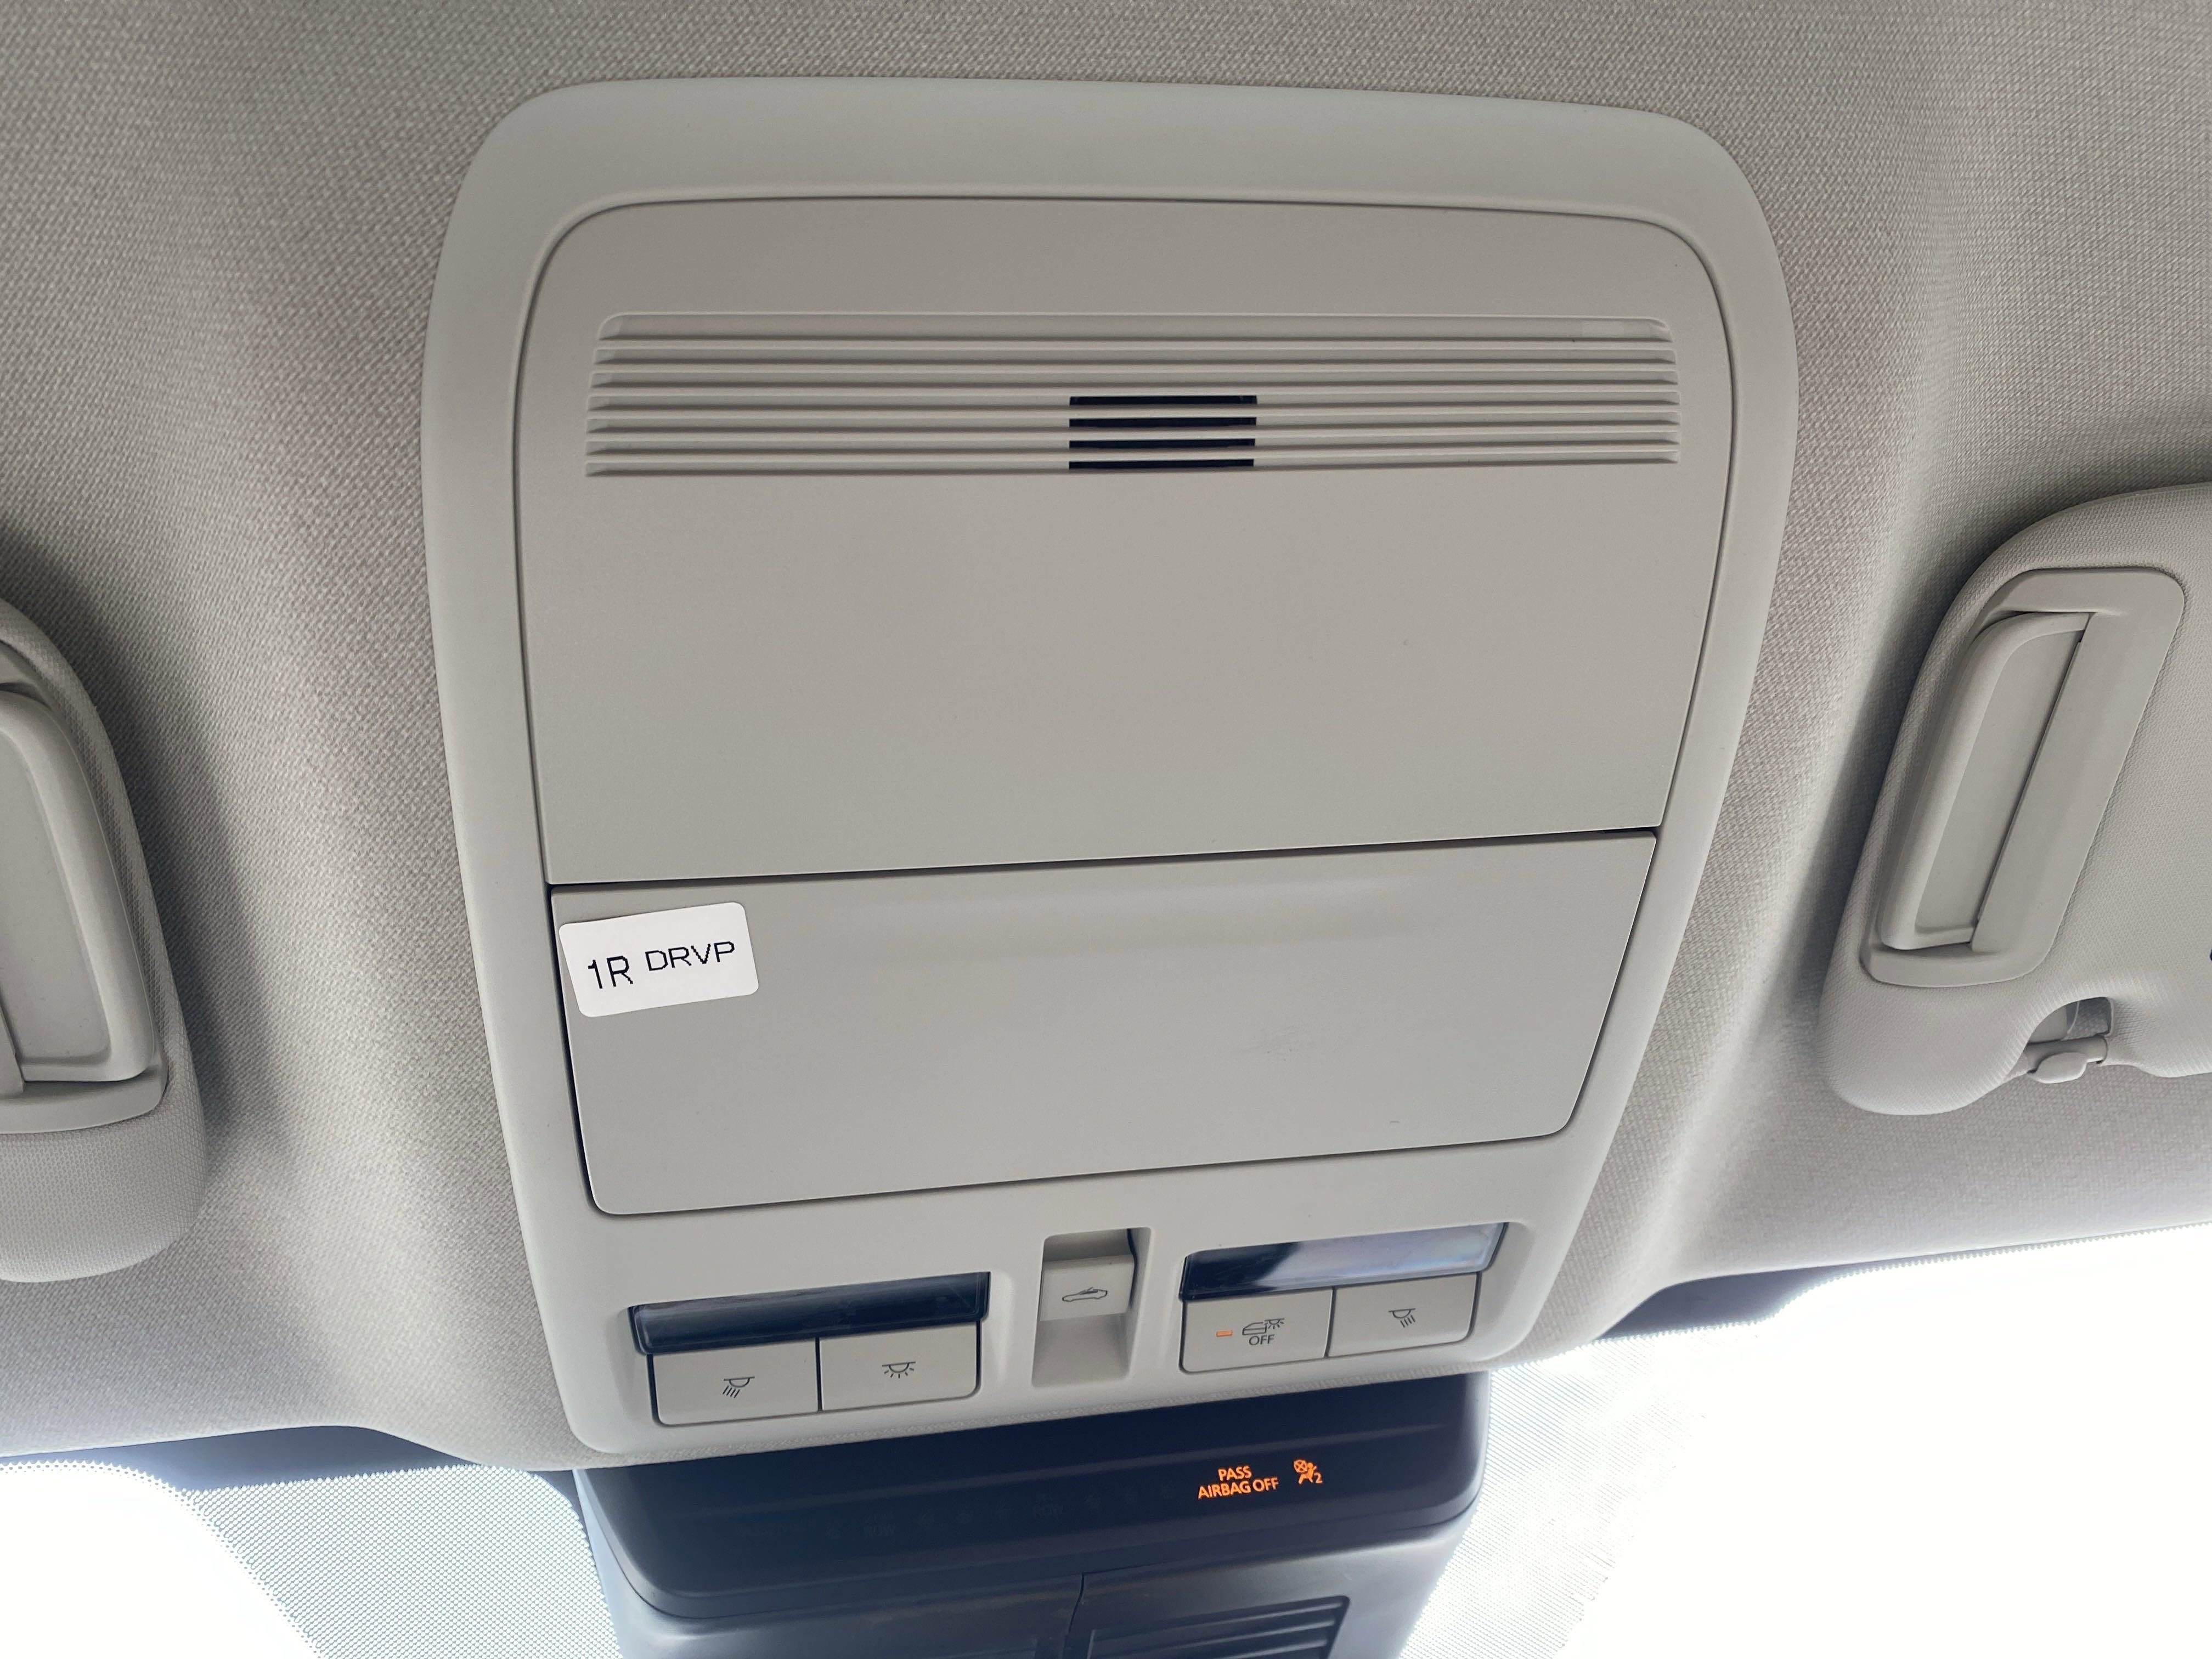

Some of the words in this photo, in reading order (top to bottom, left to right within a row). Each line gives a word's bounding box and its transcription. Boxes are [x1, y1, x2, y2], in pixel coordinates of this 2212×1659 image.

[588, 955, 634, 989] 1R
[645, 941, 735, 972] DRVP
[1249, 1334, 1275, 1346] OFF
[1218, 1465, 1252, 1481] PASS
[1198, 1481, 1251, 1499] AIRBAG
[1252, 1477, 1279, 1492] OFF
